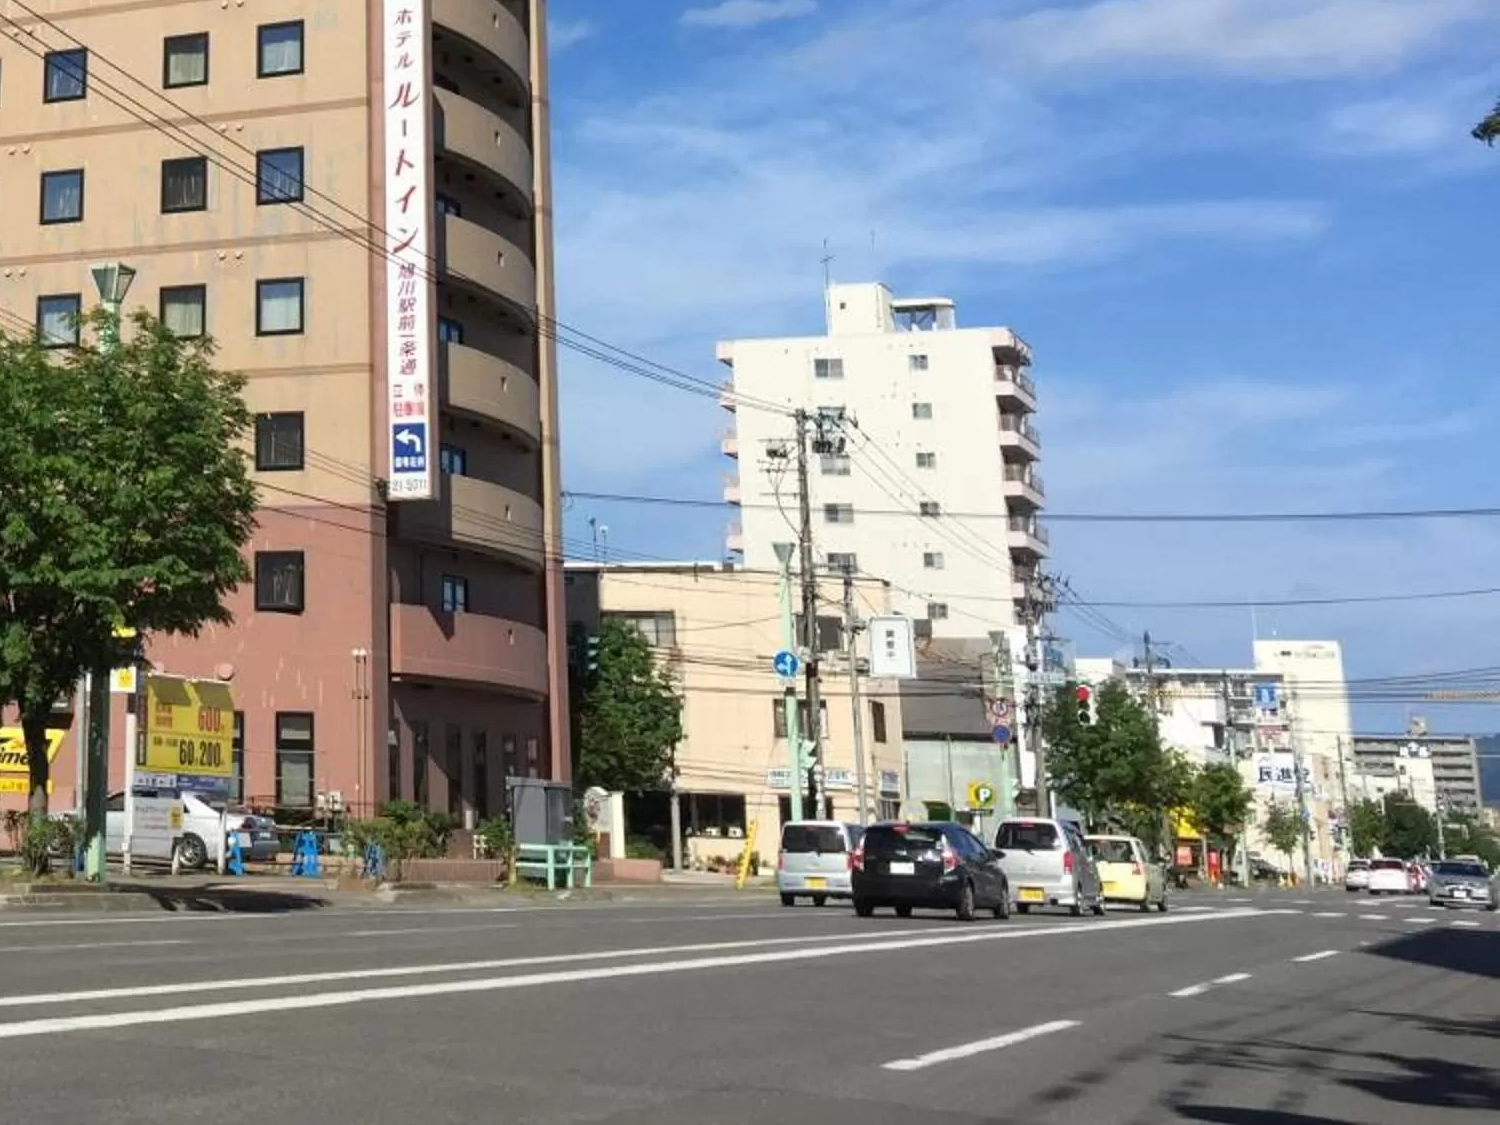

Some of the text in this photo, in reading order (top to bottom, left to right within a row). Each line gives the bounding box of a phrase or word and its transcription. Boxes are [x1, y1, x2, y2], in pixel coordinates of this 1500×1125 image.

[388, 8, 421, 254] ホテル ルートイン
